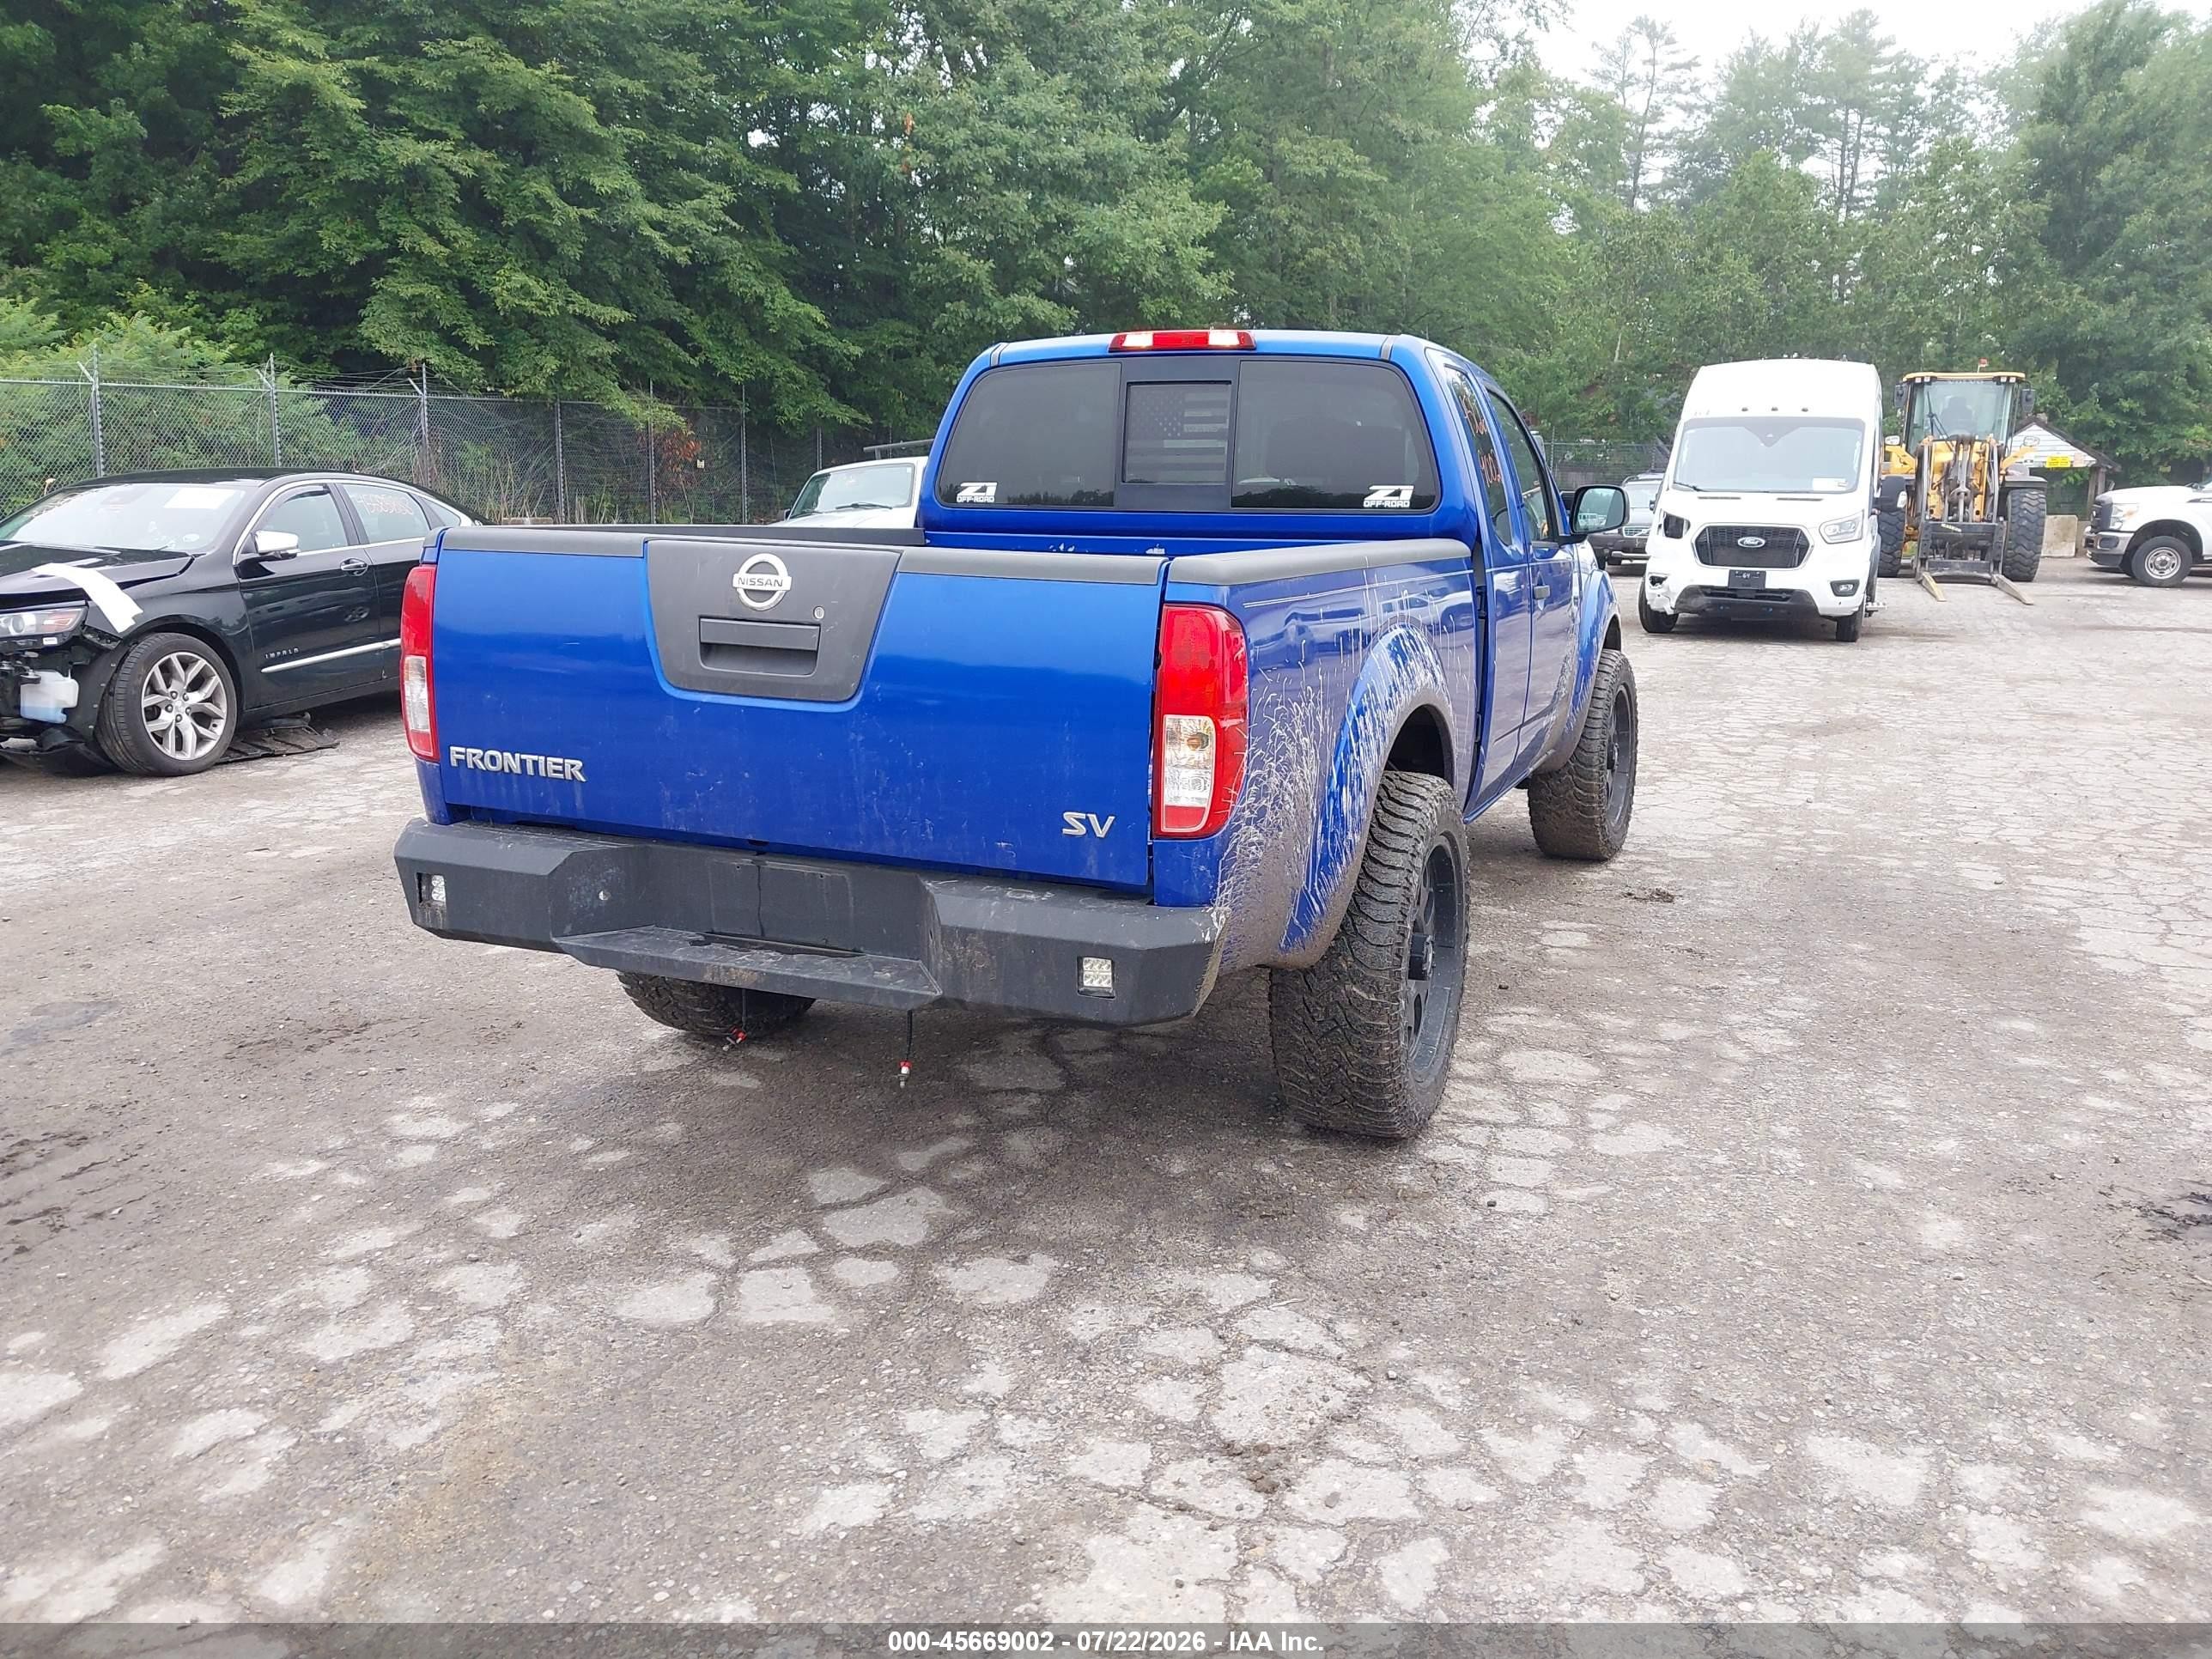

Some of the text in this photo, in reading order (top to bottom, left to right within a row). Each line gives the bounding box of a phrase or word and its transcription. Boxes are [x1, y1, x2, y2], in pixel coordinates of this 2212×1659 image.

[738, 577, 783, 587] NISSAN
[449, 745, 586, 782] FRONTIER
[1062, 811, 1115, 838] SV
